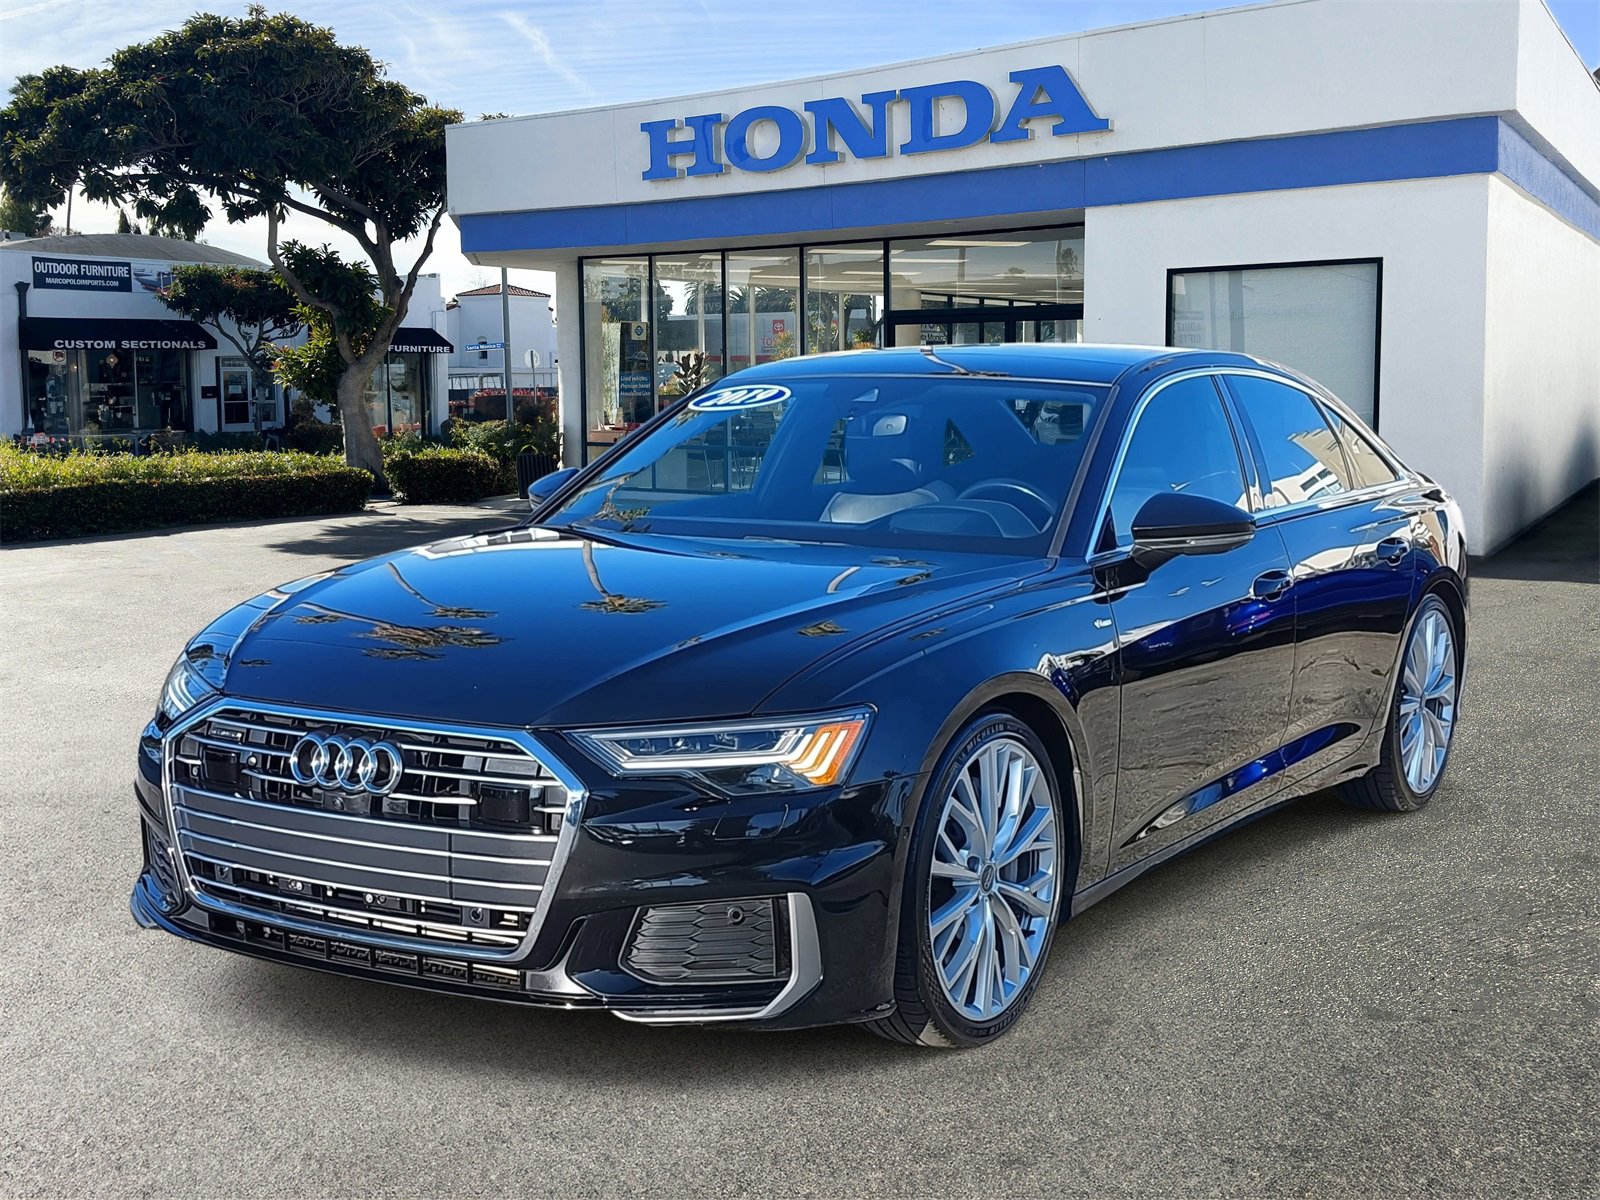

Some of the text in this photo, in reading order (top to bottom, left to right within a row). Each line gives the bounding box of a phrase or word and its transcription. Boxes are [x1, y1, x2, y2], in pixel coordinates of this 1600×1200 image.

[640, 65, 1111, 181] HONDA
[34, 262, 129, 278] OUTDOOR FURNITURE
[46, 278, 119, 286] MARCOPOLOIMPORTS.COM
[54, 340, 206, 349] CUSTOM SECTIONALS
[388, 345, 450, 353] FURNITURE
[699, 389, 779, 406] 2019
[967, 723, 1004, 752] MICHELIN
